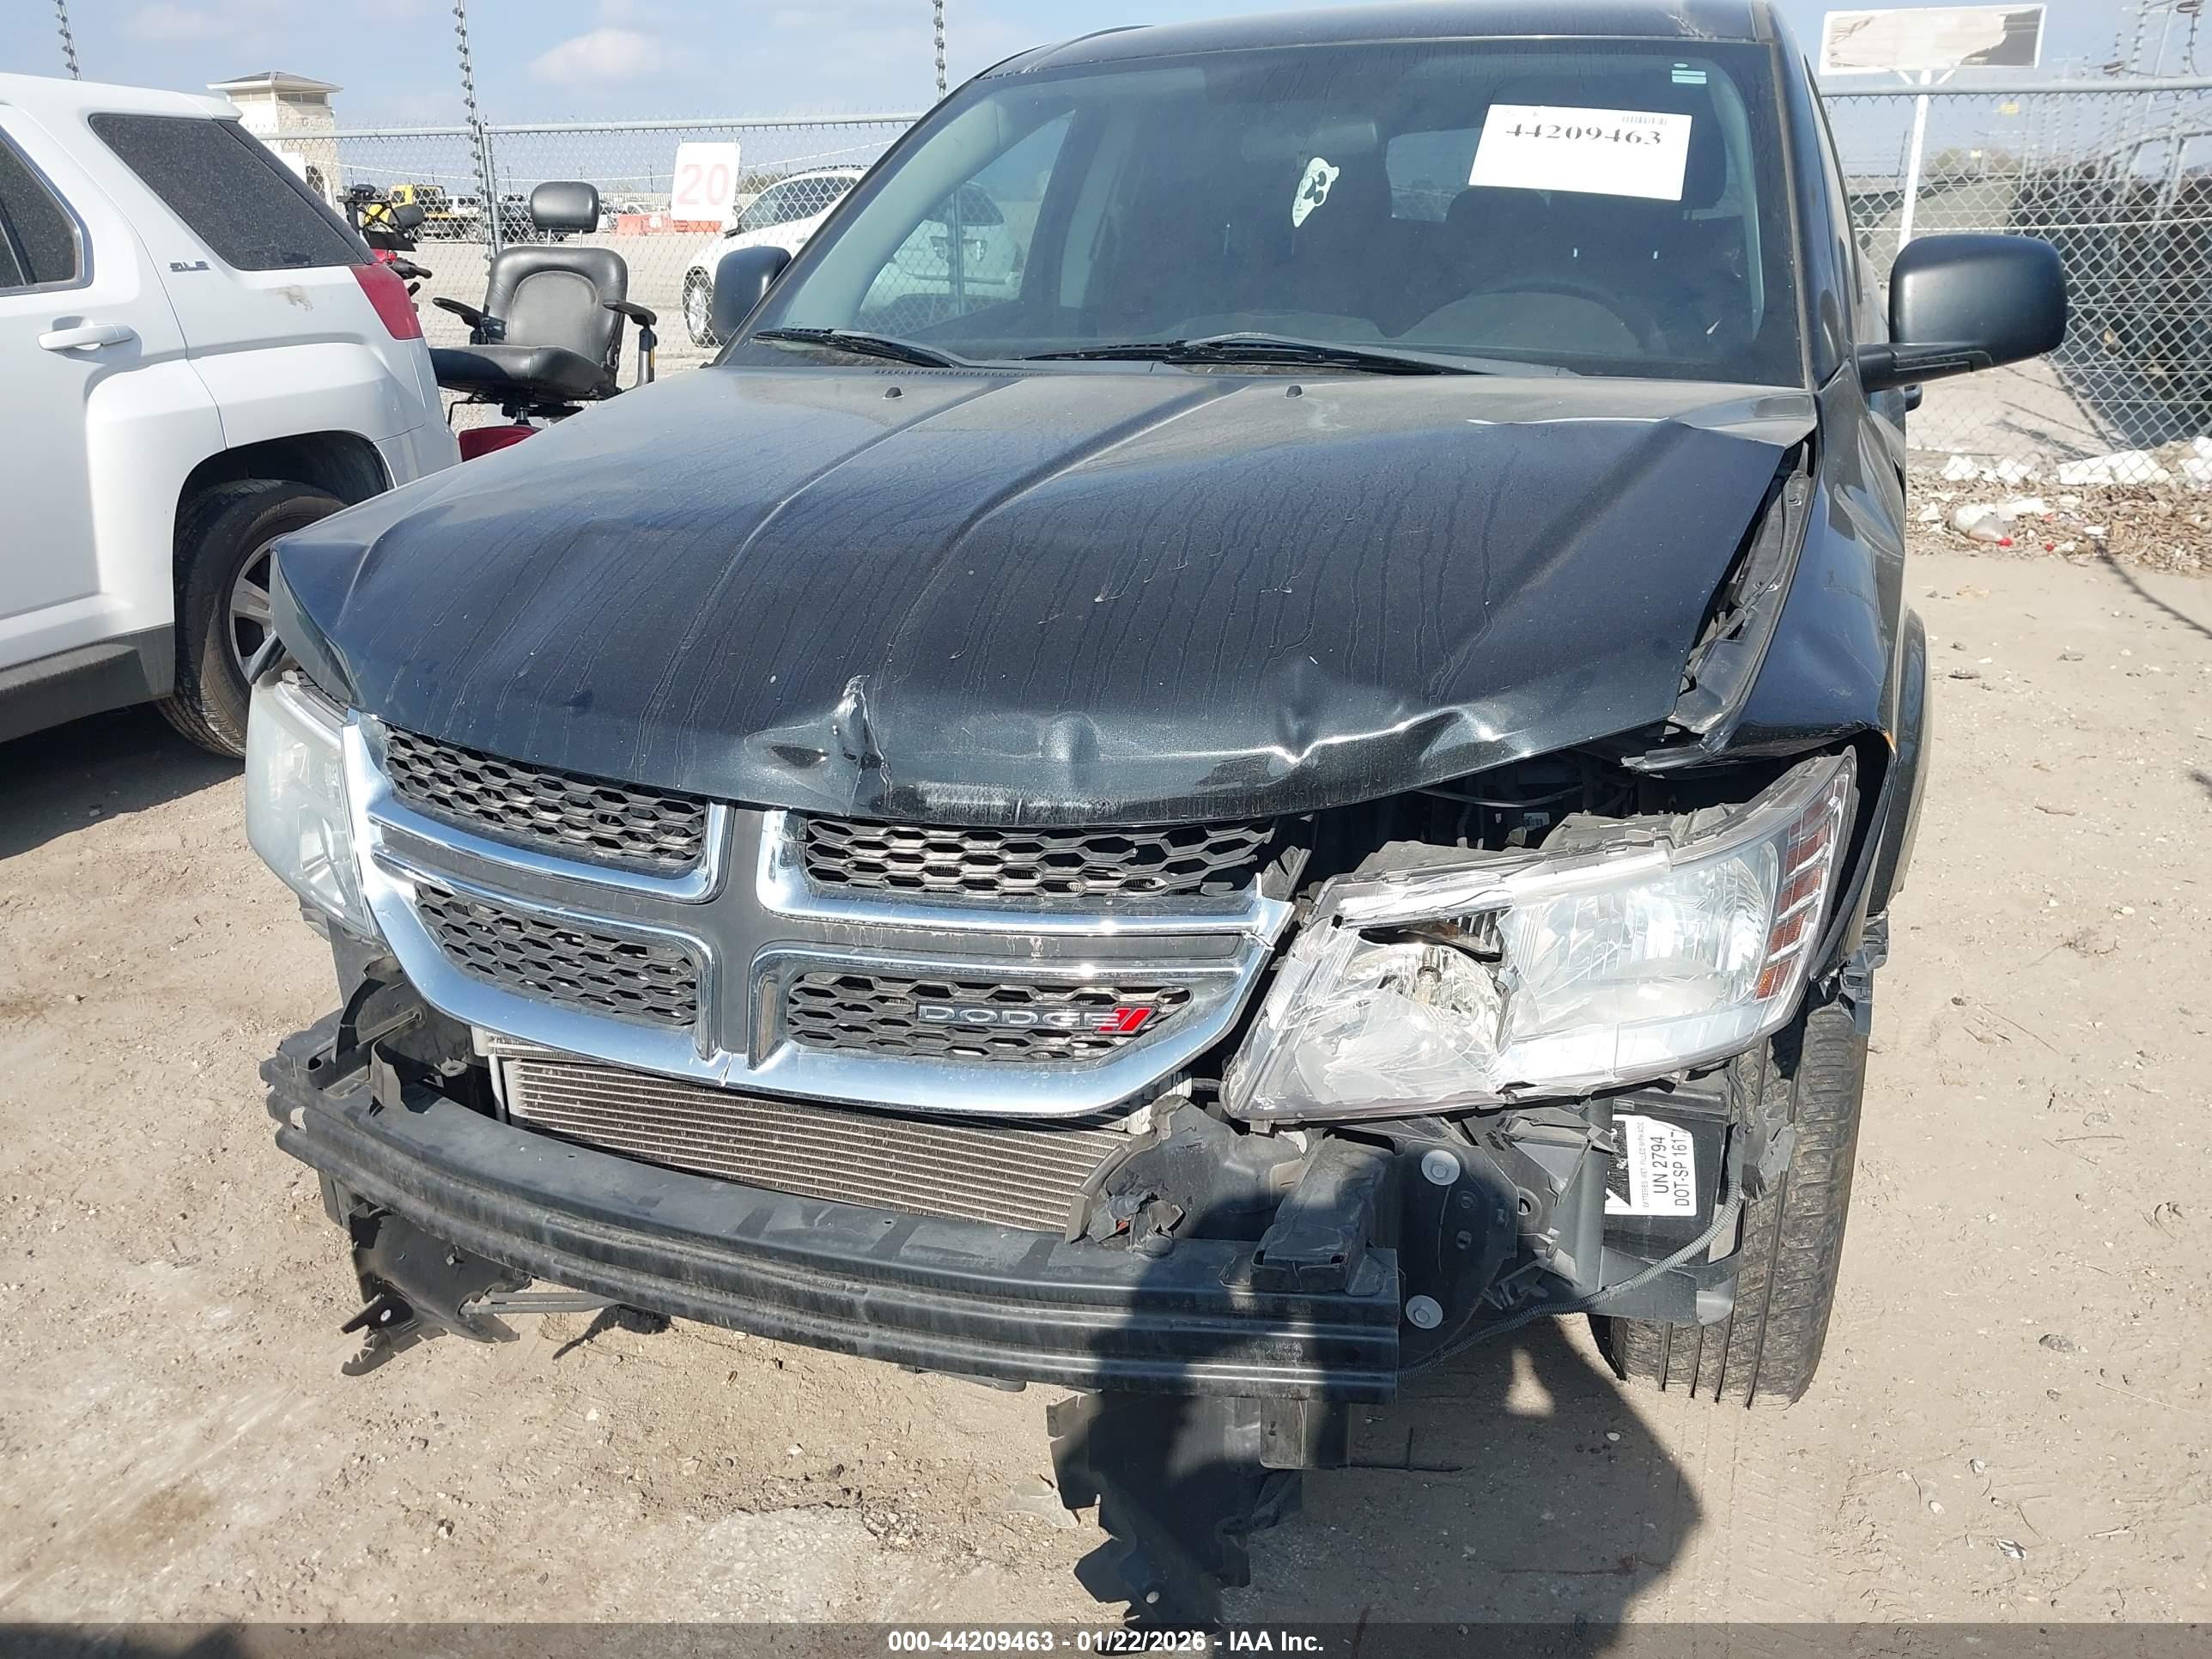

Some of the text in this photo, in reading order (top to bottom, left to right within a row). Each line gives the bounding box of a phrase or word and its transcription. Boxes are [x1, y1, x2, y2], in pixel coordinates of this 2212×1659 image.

[1505, 123, 1662, 145] 44209463
[677, 163, 730, 206] 20
[918, 1005, 1121, 1028] DODGE
[1650, 1135, 1669, 1194] UN 2794
